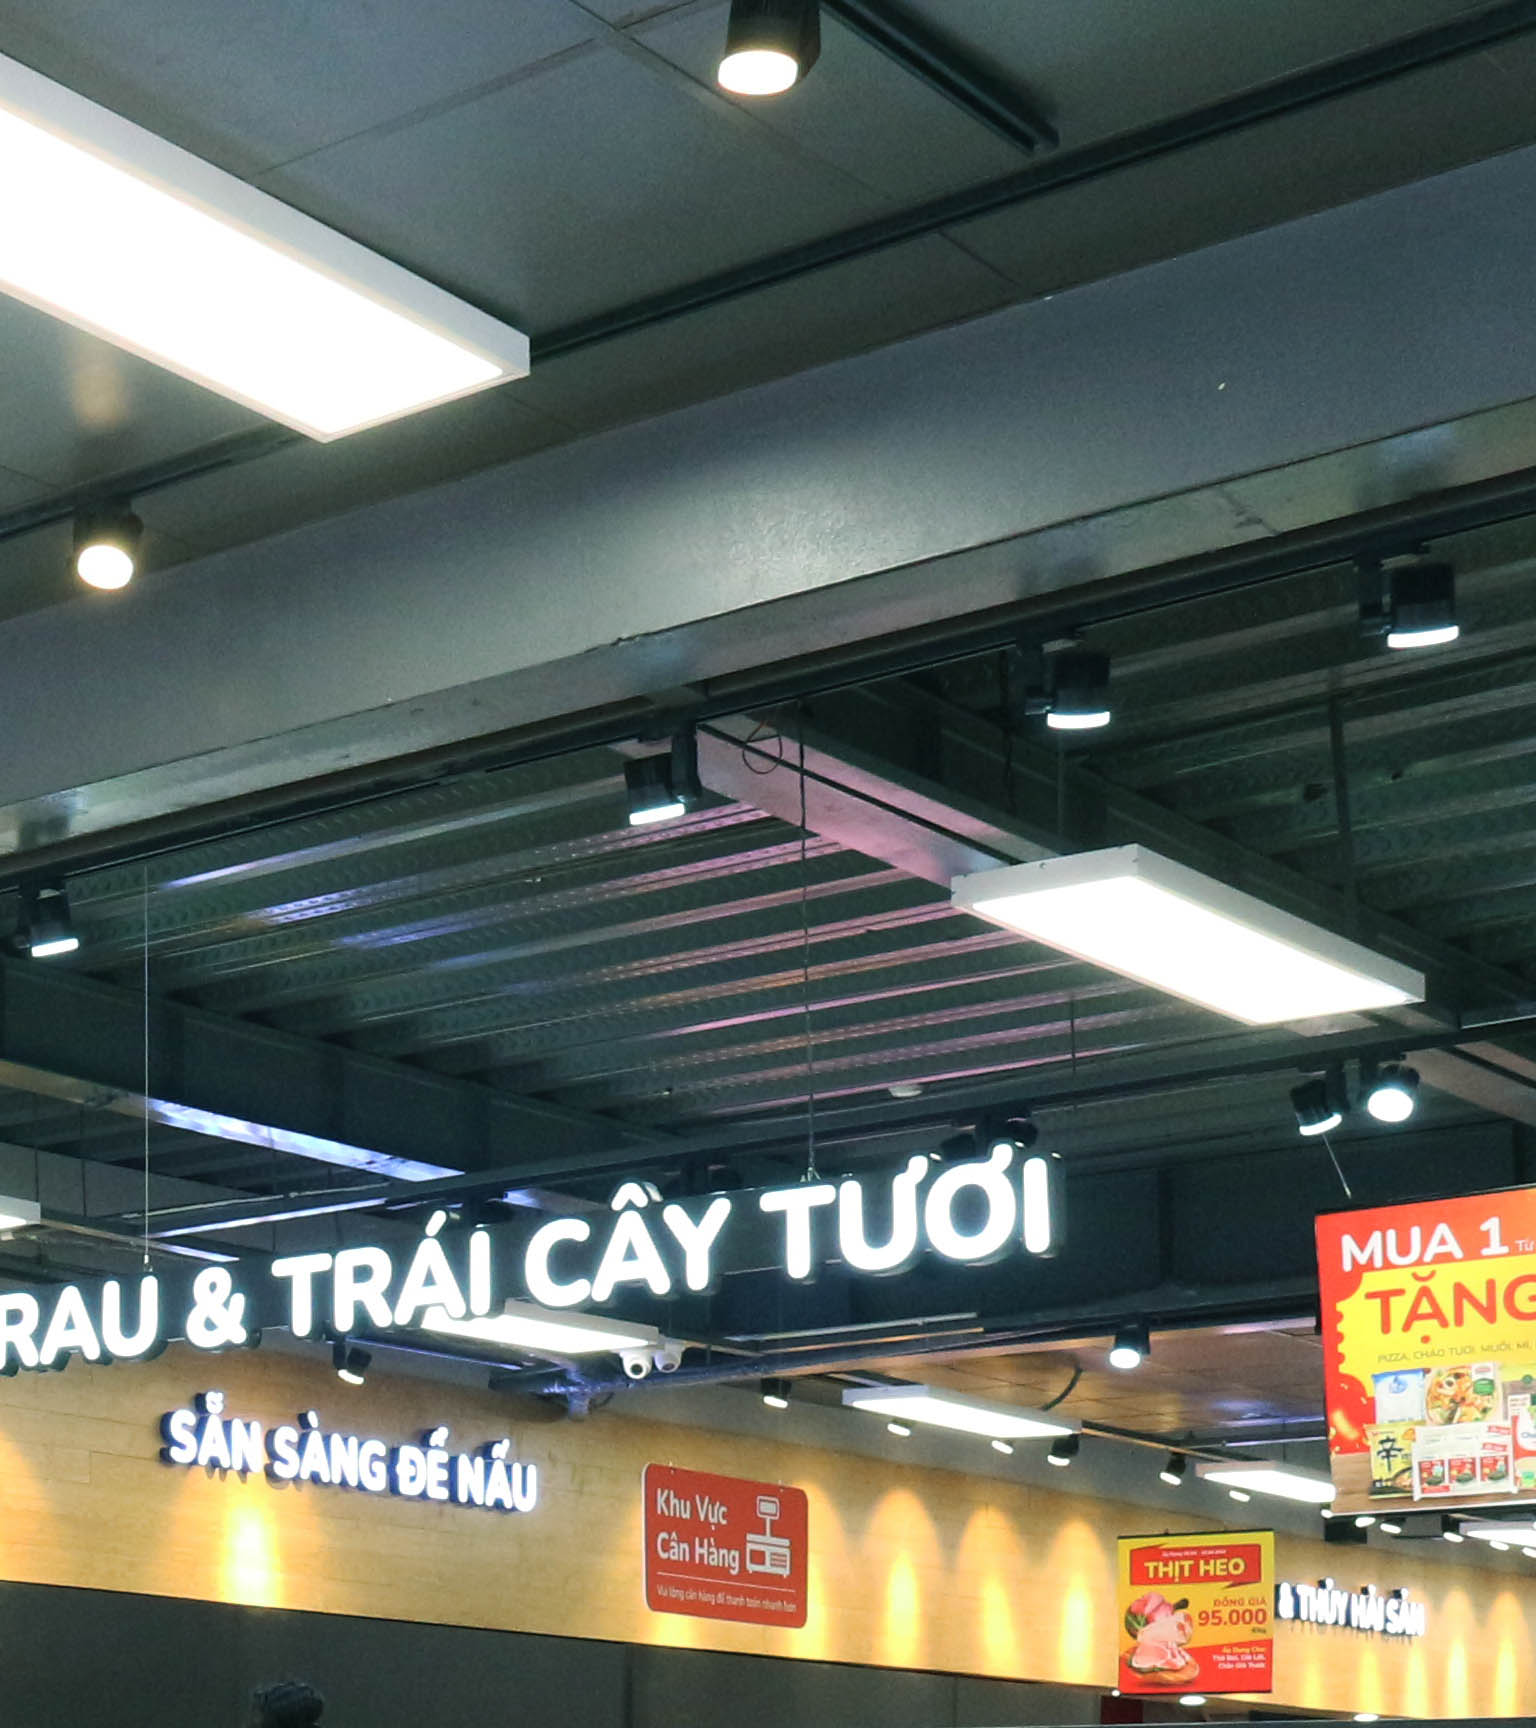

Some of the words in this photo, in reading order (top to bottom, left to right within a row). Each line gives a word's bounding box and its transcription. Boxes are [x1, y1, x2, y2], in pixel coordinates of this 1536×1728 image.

[185, 1267, 250, 1350] &
[271, 1210, 492, 1340] TRÁI
[525, 1182, 731, 1308] CÂY
[759, 1143, 1052, 1282] TƯƠI
[1341, 1223, 1464, 1272] MUA
[1480, 1216, 1510, 1257] 1
[1364, 1270, 1536, 1344] TẶNG
[266, 1410, 387, 1491] SÀNG
[451, 1438, 537, 1512] NẤU
[1377, 1436, 1403, 1472] 辛
[656, 1488, 690, 1520] Khu
[695, 1494, 728, 1530] Vực
[657, 1531, 689, 1562] Cân
[695, 1537, 740, 1576] Hàng
[1144, 1560, 1194, 1582] THỊT
[1199, 1557, 1245, 1577] HEO
[1198, 1609, 1267, 1626] 95.000
